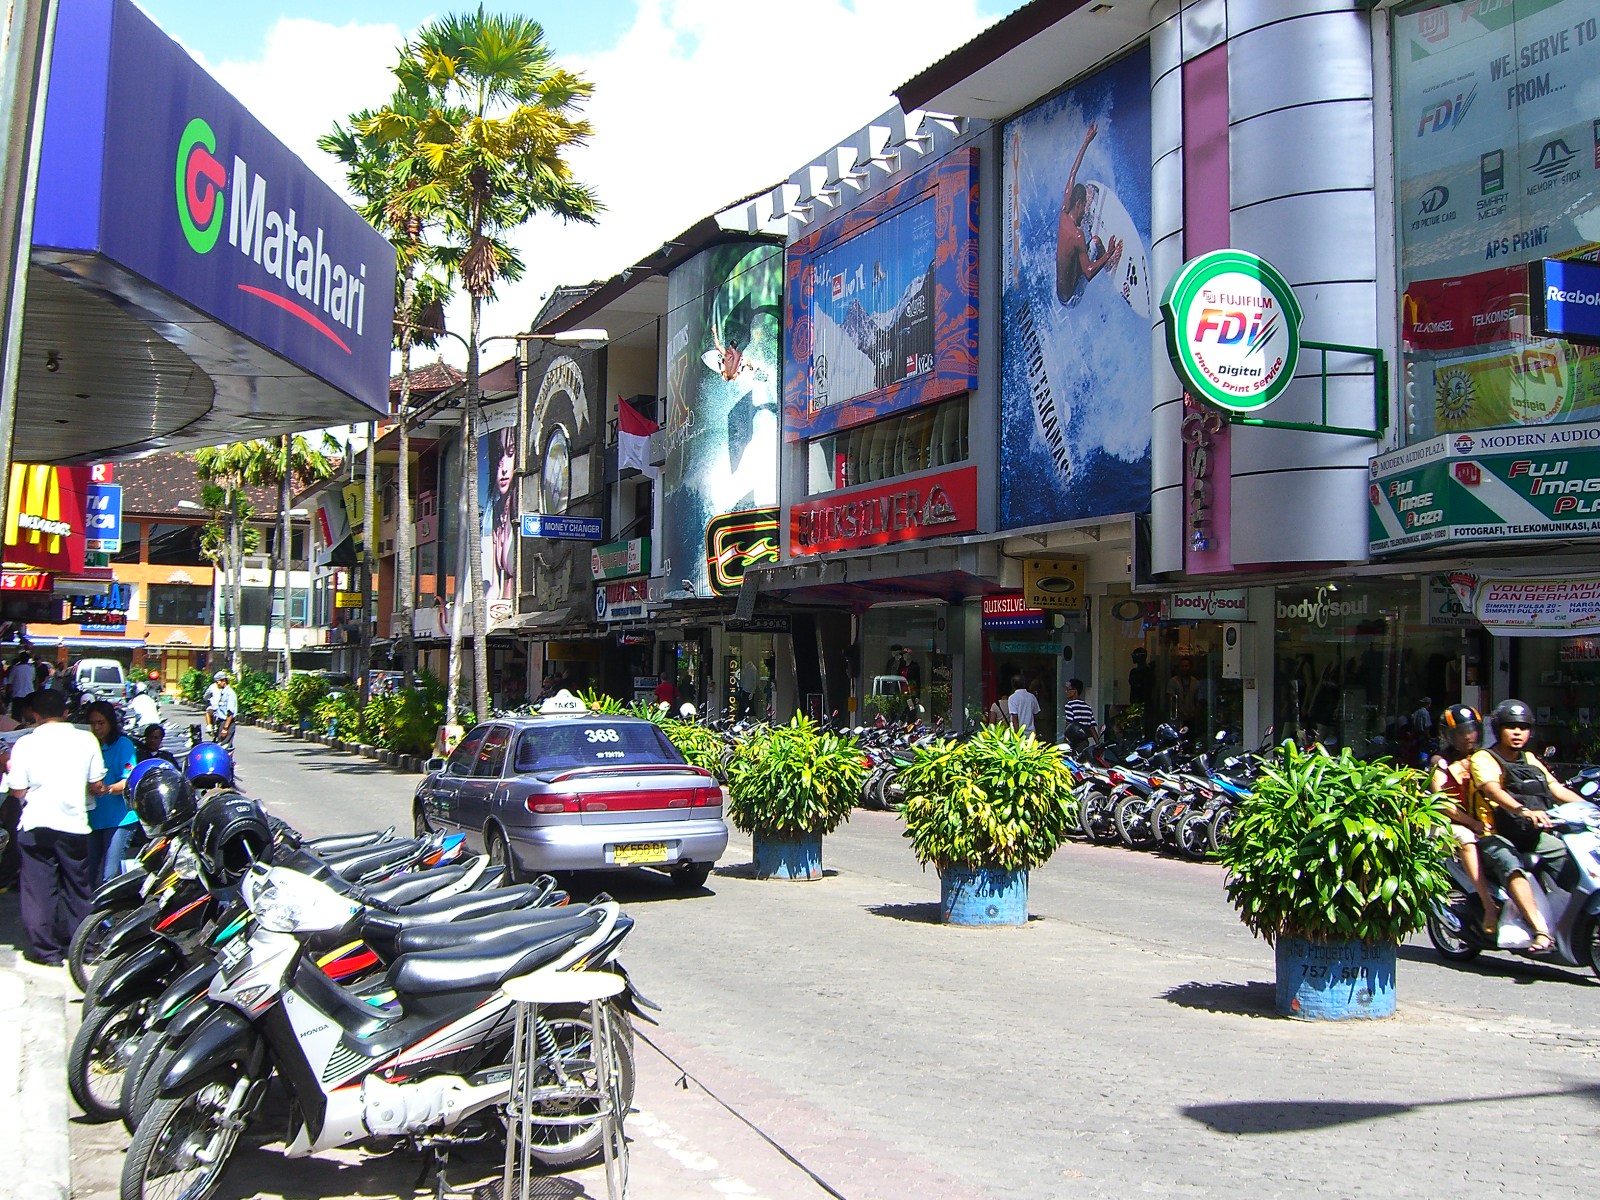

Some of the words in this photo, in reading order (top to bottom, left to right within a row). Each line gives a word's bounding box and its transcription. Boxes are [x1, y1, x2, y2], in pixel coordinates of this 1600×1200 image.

[1574, 17, 1597, 46] TO
[1526, 179, 1557, 196] MEMORY
[1561, 169, 1581, 185] STICK
[228, 155, 366, 335] Matahari
[1485, 238, 1509, 260] APS
[1220, 293, 1273, 309] FUJIFILM
[1471, 307, 1519, 327] TELKOMSEL
[1195, 351, 1220, 384] Photo
[1217, 364, 1262, 377] Digital
[1481, 433, 1546, 449] MODERN
[1550, 428, 1600, 443] AUDIO
[1380, 455, 1405, 472] MODERN
[1405, 449, 1425, 464] AUDIO
[1425, 443, 1445, 457] PLAZA
[1508, 460, 1569, 479] FUJI
[1398, 492, 1434, 513] IMAGE
[798, 489, 920, 547] QUIKSILVER
[1406, 509, 1444, 529] PLAZA
[544, 522, 568, 532] MONEY
[568, 523, 600, 534] CHANGER
[1454, 526, 1506, 537] FOTOGRAFI,
[1507, 521, 1590, 535] TELEKOMUNIKASI,
[1488, 592, 1521, 601] DAN
[1491, 584, 1567, 593] VOUCHER
[1033, 595, 1078, 604] OAKLEY
[554, 701, 578, 709] TAKSI
[613, 844, 629, 857] DK
[630, 843, 651, 856] 556
[1301, 964, 1328, 978] 757
[299, 1023, 330, 1040] HONDA
